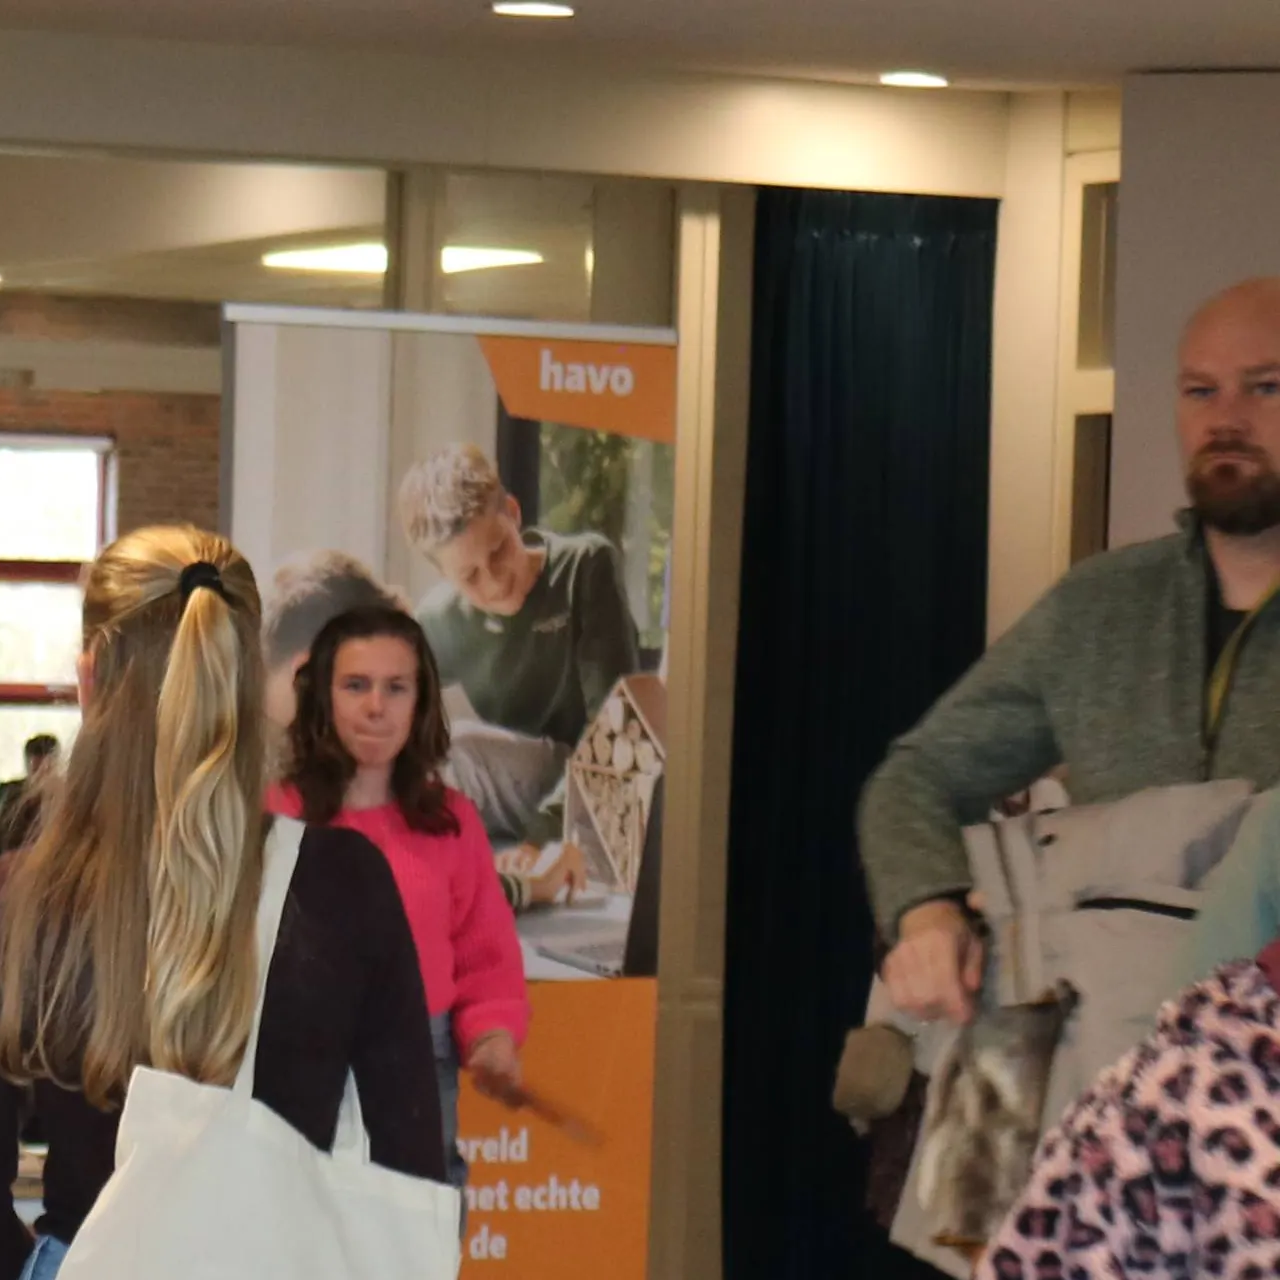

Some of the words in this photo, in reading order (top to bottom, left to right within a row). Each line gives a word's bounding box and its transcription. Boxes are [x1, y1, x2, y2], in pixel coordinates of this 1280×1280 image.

[541, 348, 634, 396] havo
[514, 1174, 600, 1211] echte
[469, 1223, 507, 1260] de
